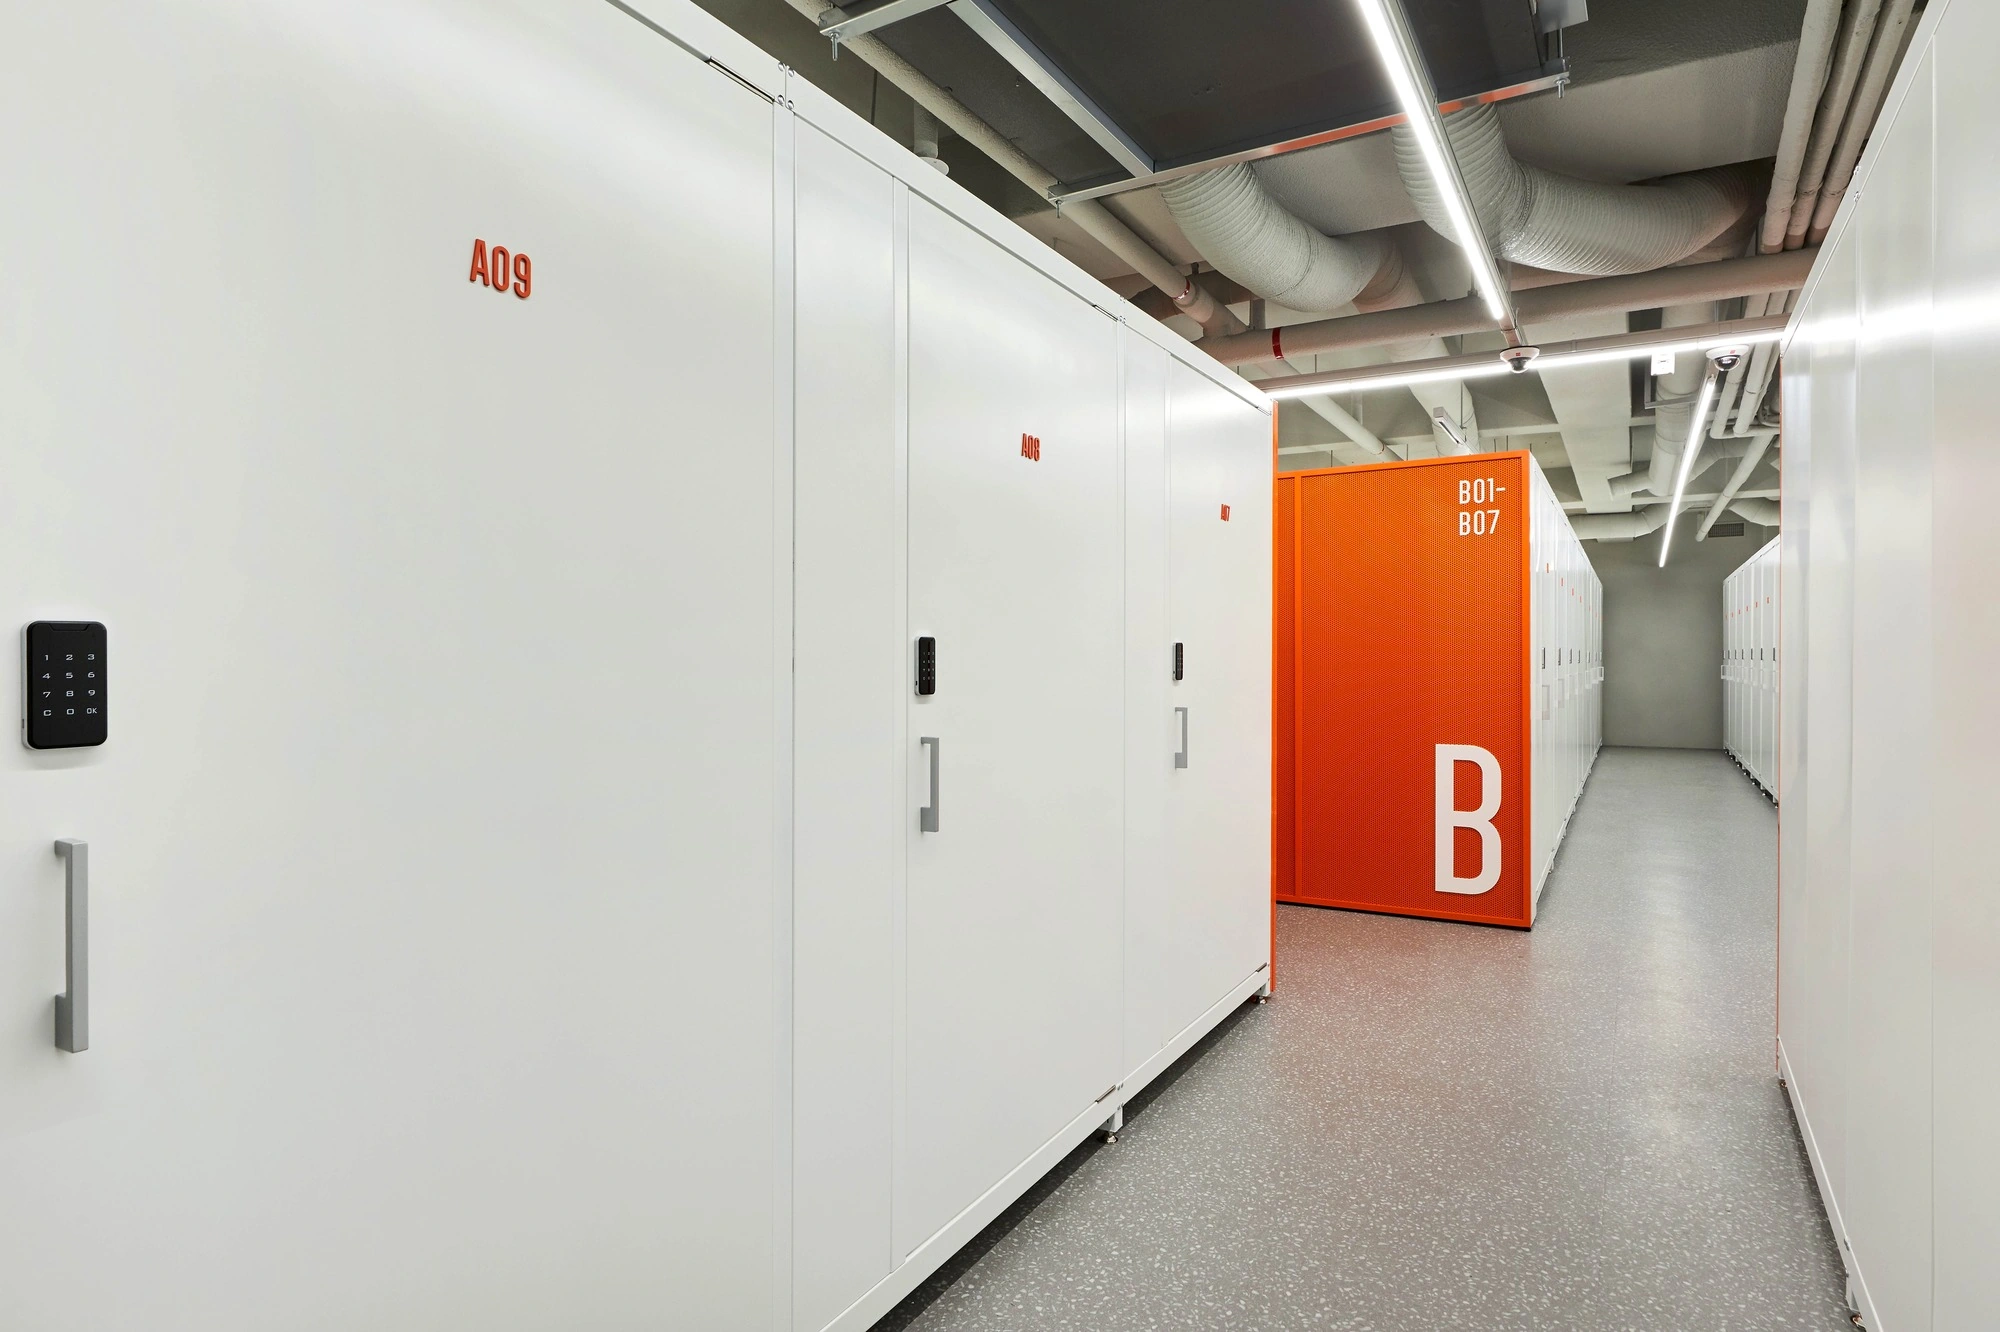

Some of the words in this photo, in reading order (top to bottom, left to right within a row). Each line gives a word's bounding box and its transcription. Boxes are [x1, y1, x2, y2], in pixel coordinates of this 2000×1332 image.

[469, 238, 531, 299] A09
[1021, 432, 1040, 462] A08
[1459, 477, 1506, 505] B01-
[1459, 509, 1500, 536] B07
[87, 653, 95, 661] 3
[42, 672, 51, 680] 4
[87, 671, 95, 679] 6
[88, 689, 96, 697] 9
[43, 709, 52, 717] C
[86, 707, 98, 715] OK
[1435, 743, 1502, 895] B
